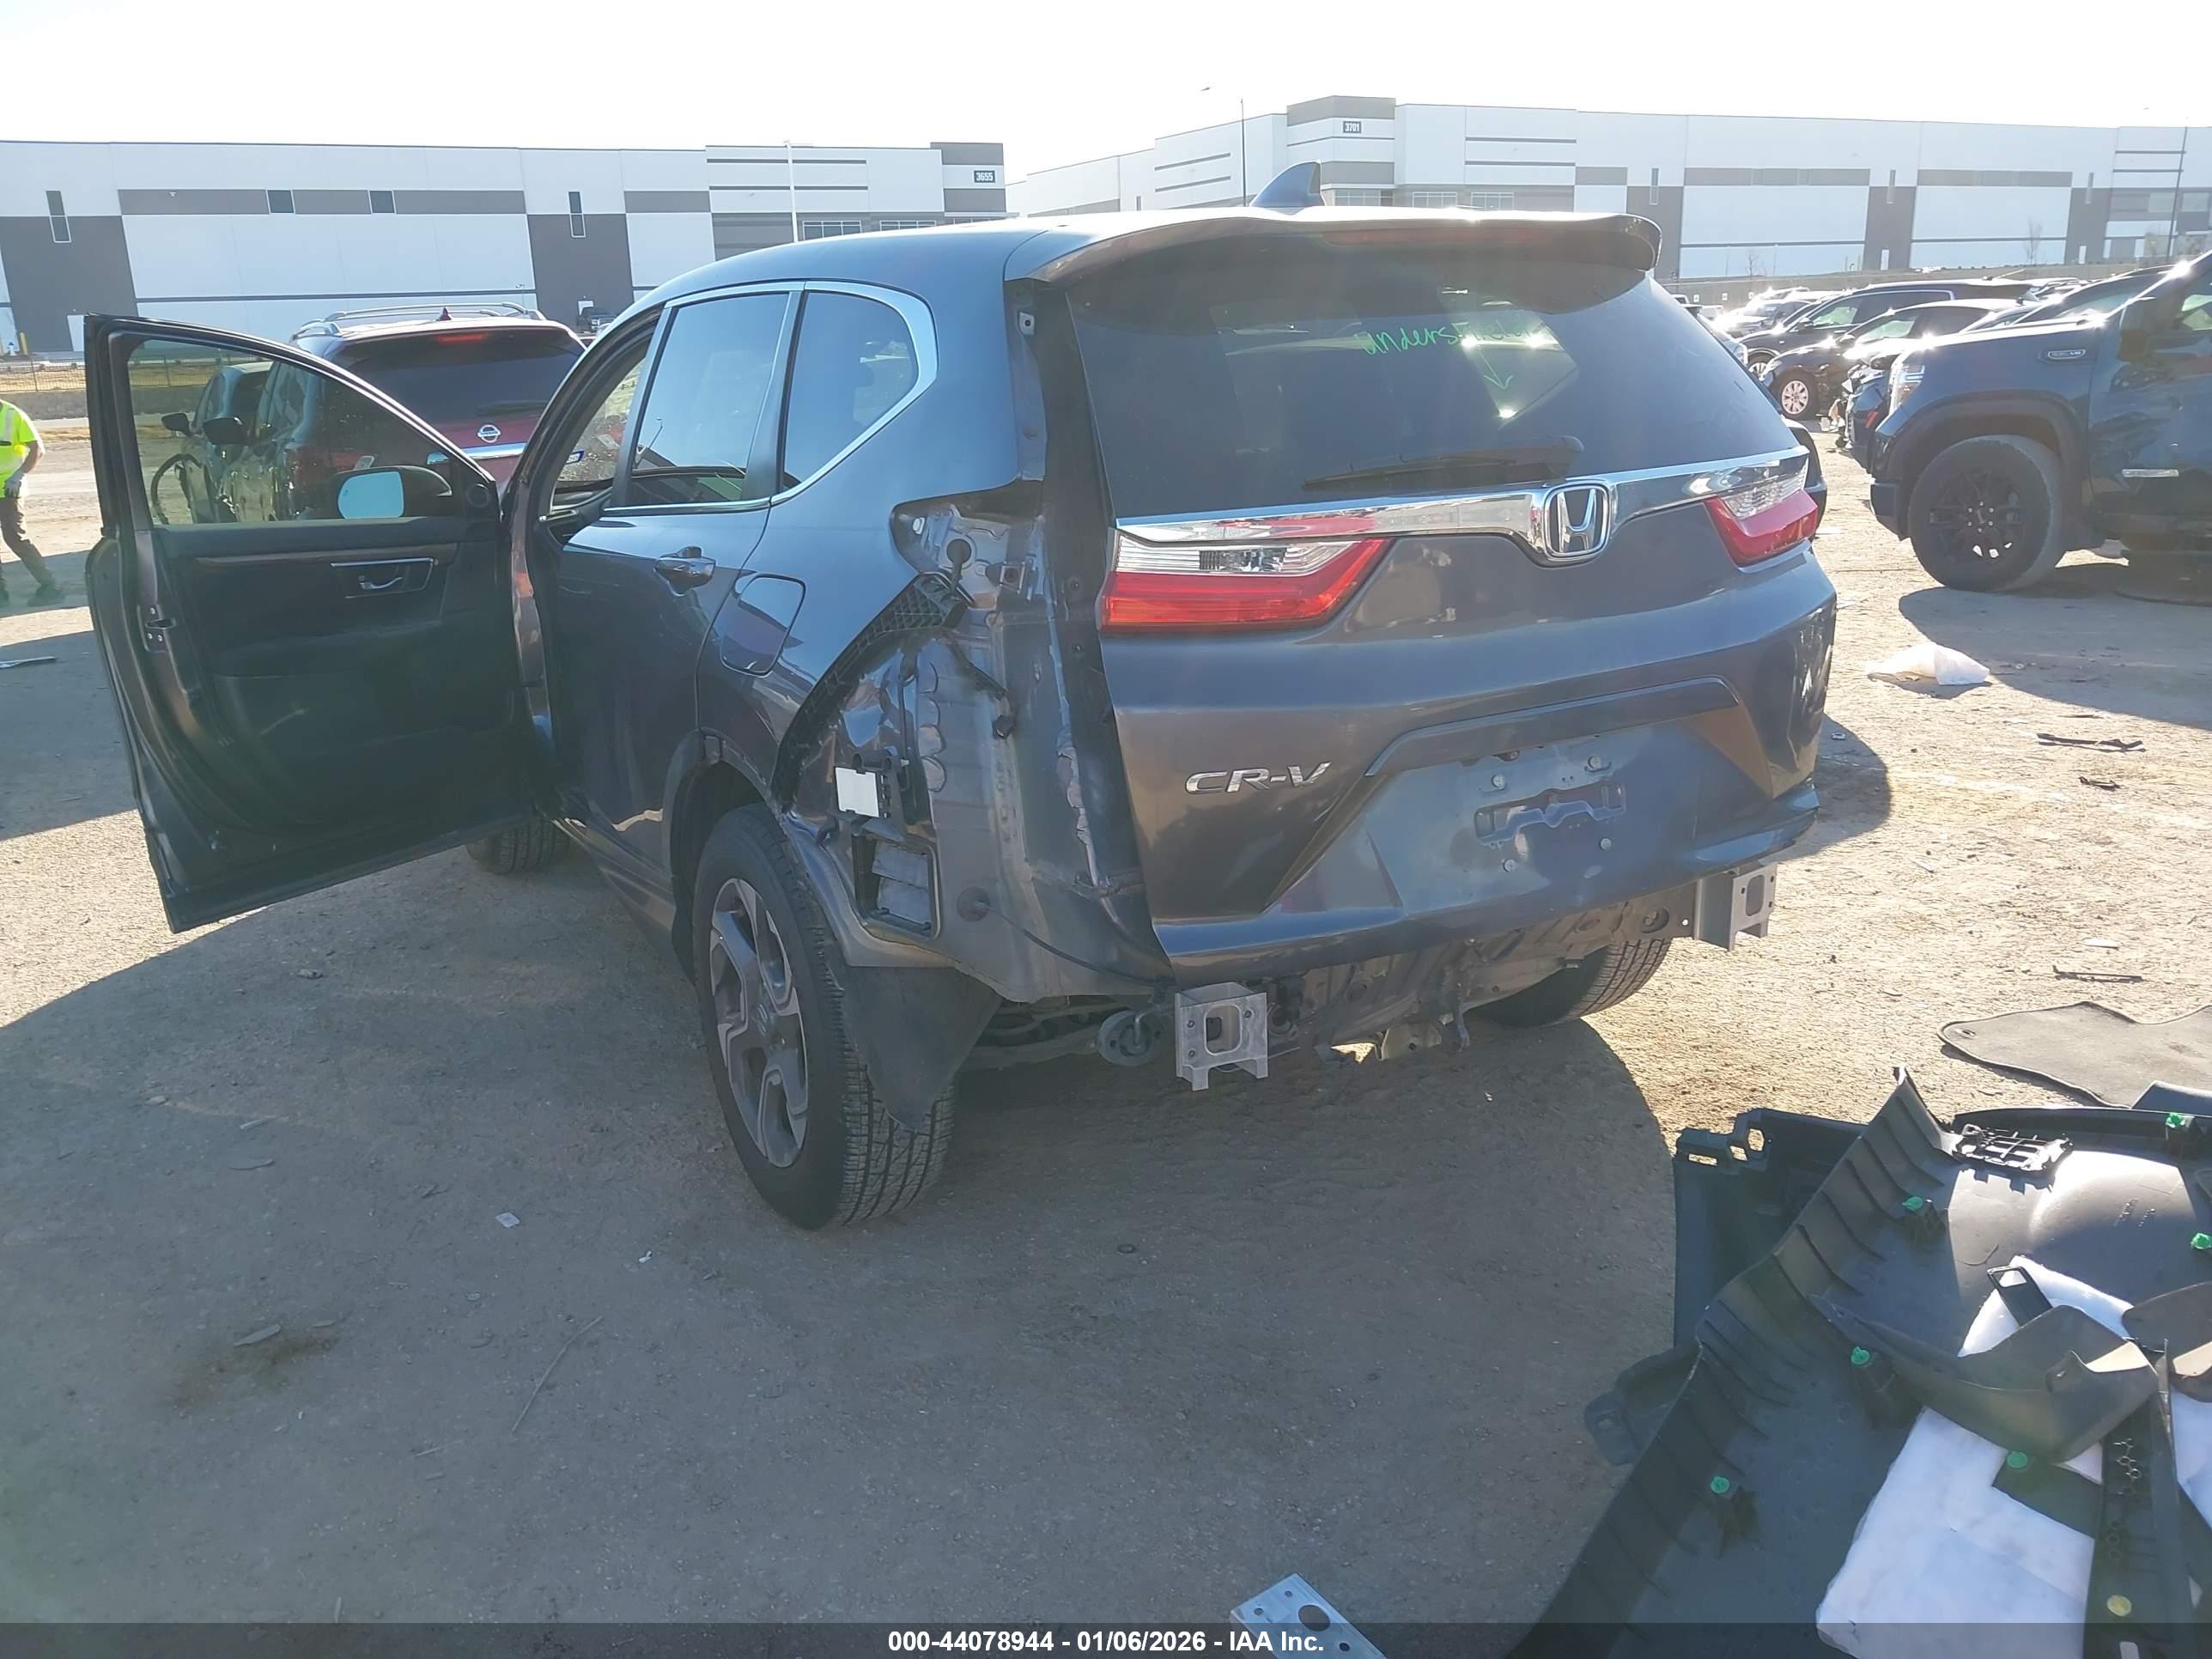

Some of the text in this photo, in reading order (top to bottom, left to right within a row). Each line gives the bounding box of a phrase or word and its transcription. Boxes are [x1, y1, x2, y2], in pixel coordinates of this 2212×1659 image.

[1345, 123, 1360, 131] 3701
[975, 172, 994, 181] 3655
[1185, 762, 1332, 795] CR-V
